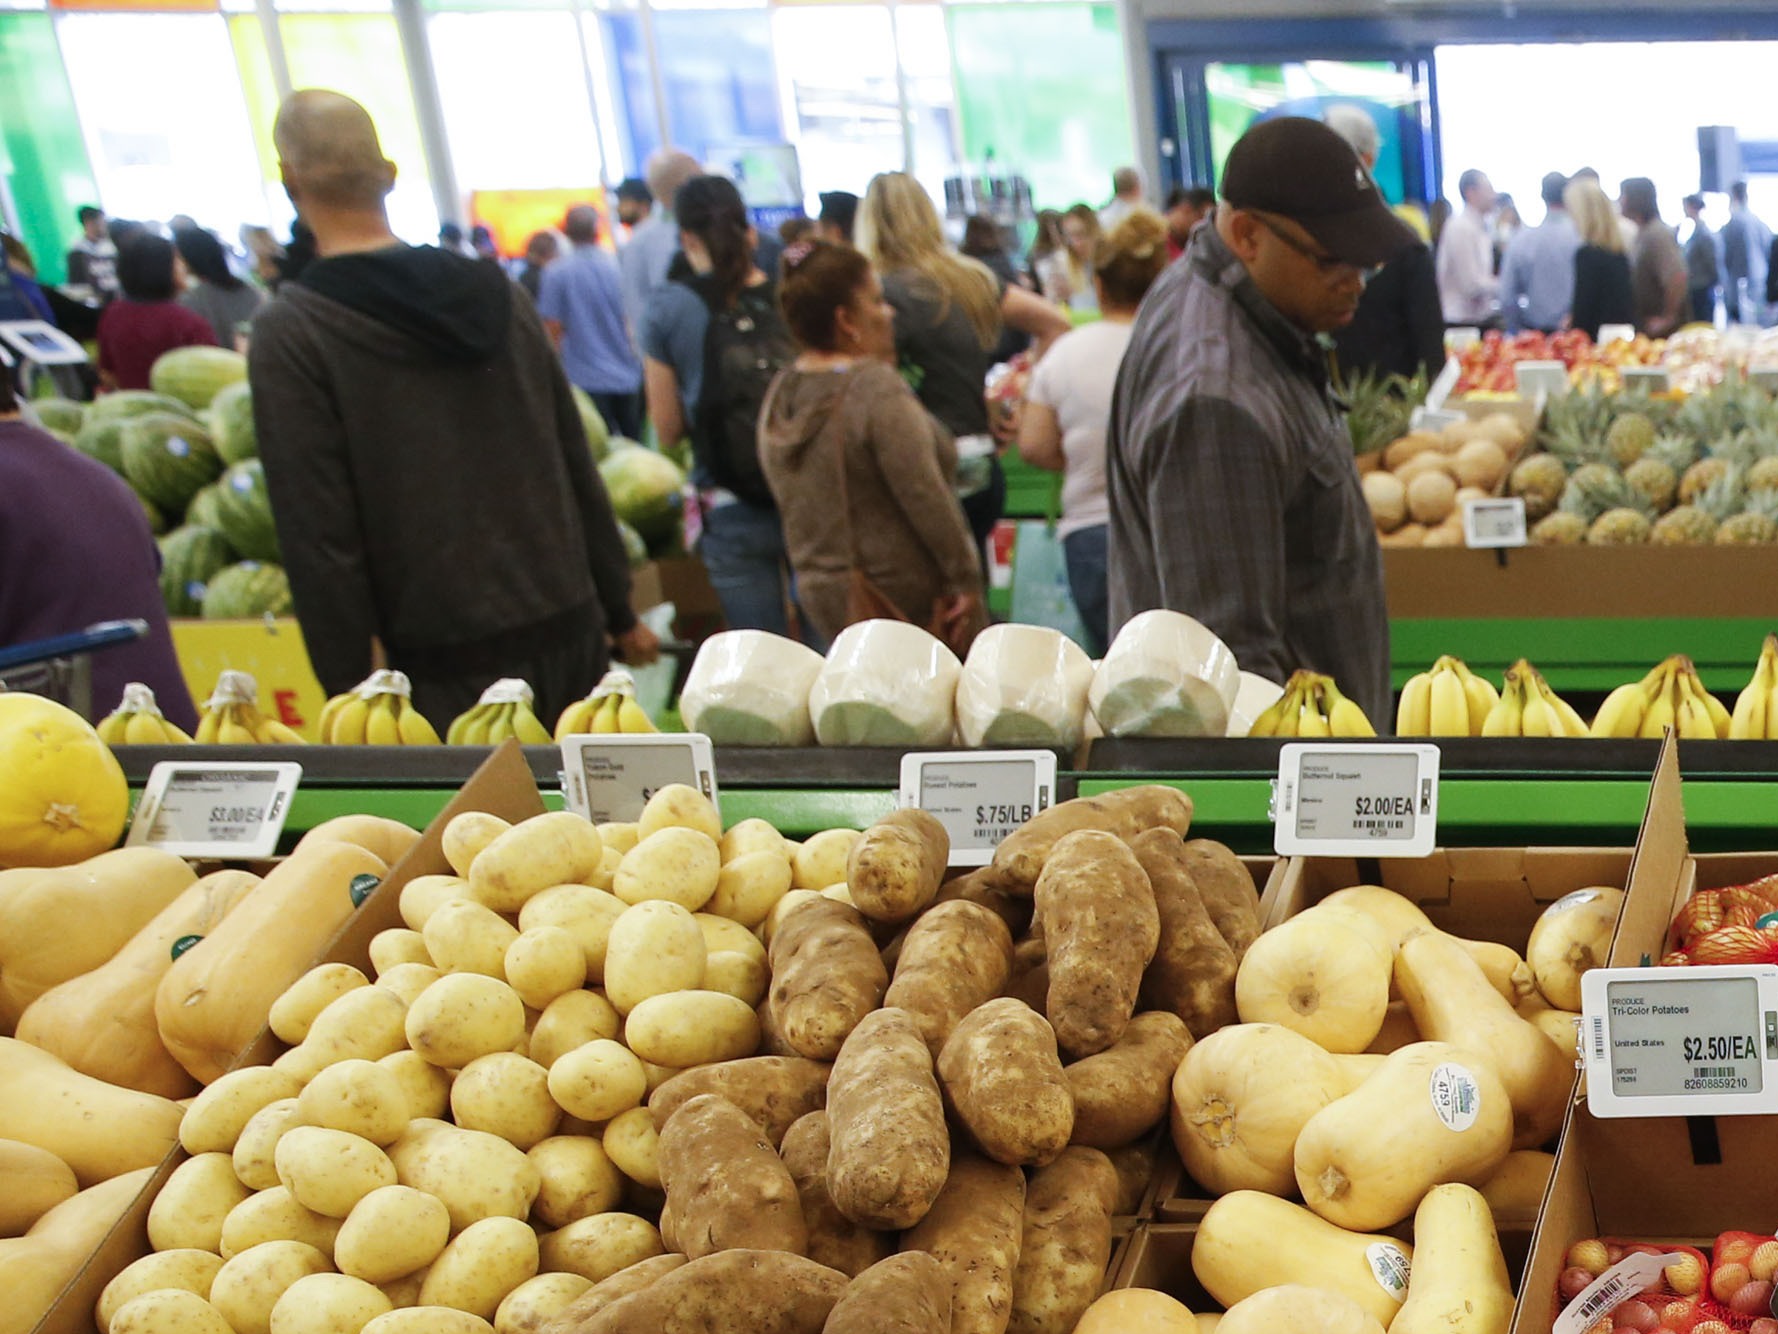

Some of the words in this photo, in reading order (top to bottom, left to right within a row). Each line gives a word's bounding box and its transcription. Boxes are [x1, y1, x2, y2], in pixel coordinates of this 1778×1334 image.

[976, 804, 1031, 825] $.75/LB
[1355, 797, 1413, 816] $2.00/EA
[1612, 1006, 1649, 1016] Tri-Color
[1652, 1006, 1689, 1015] Potatoes
[1615, 1039, 1640, 1047] United
[1684, 1036, 1757, 1064] $2.50/EA
[1438, 1081, 1450, 1106] 4759
[1684, 1079, 1748, 1089] 82608859210
